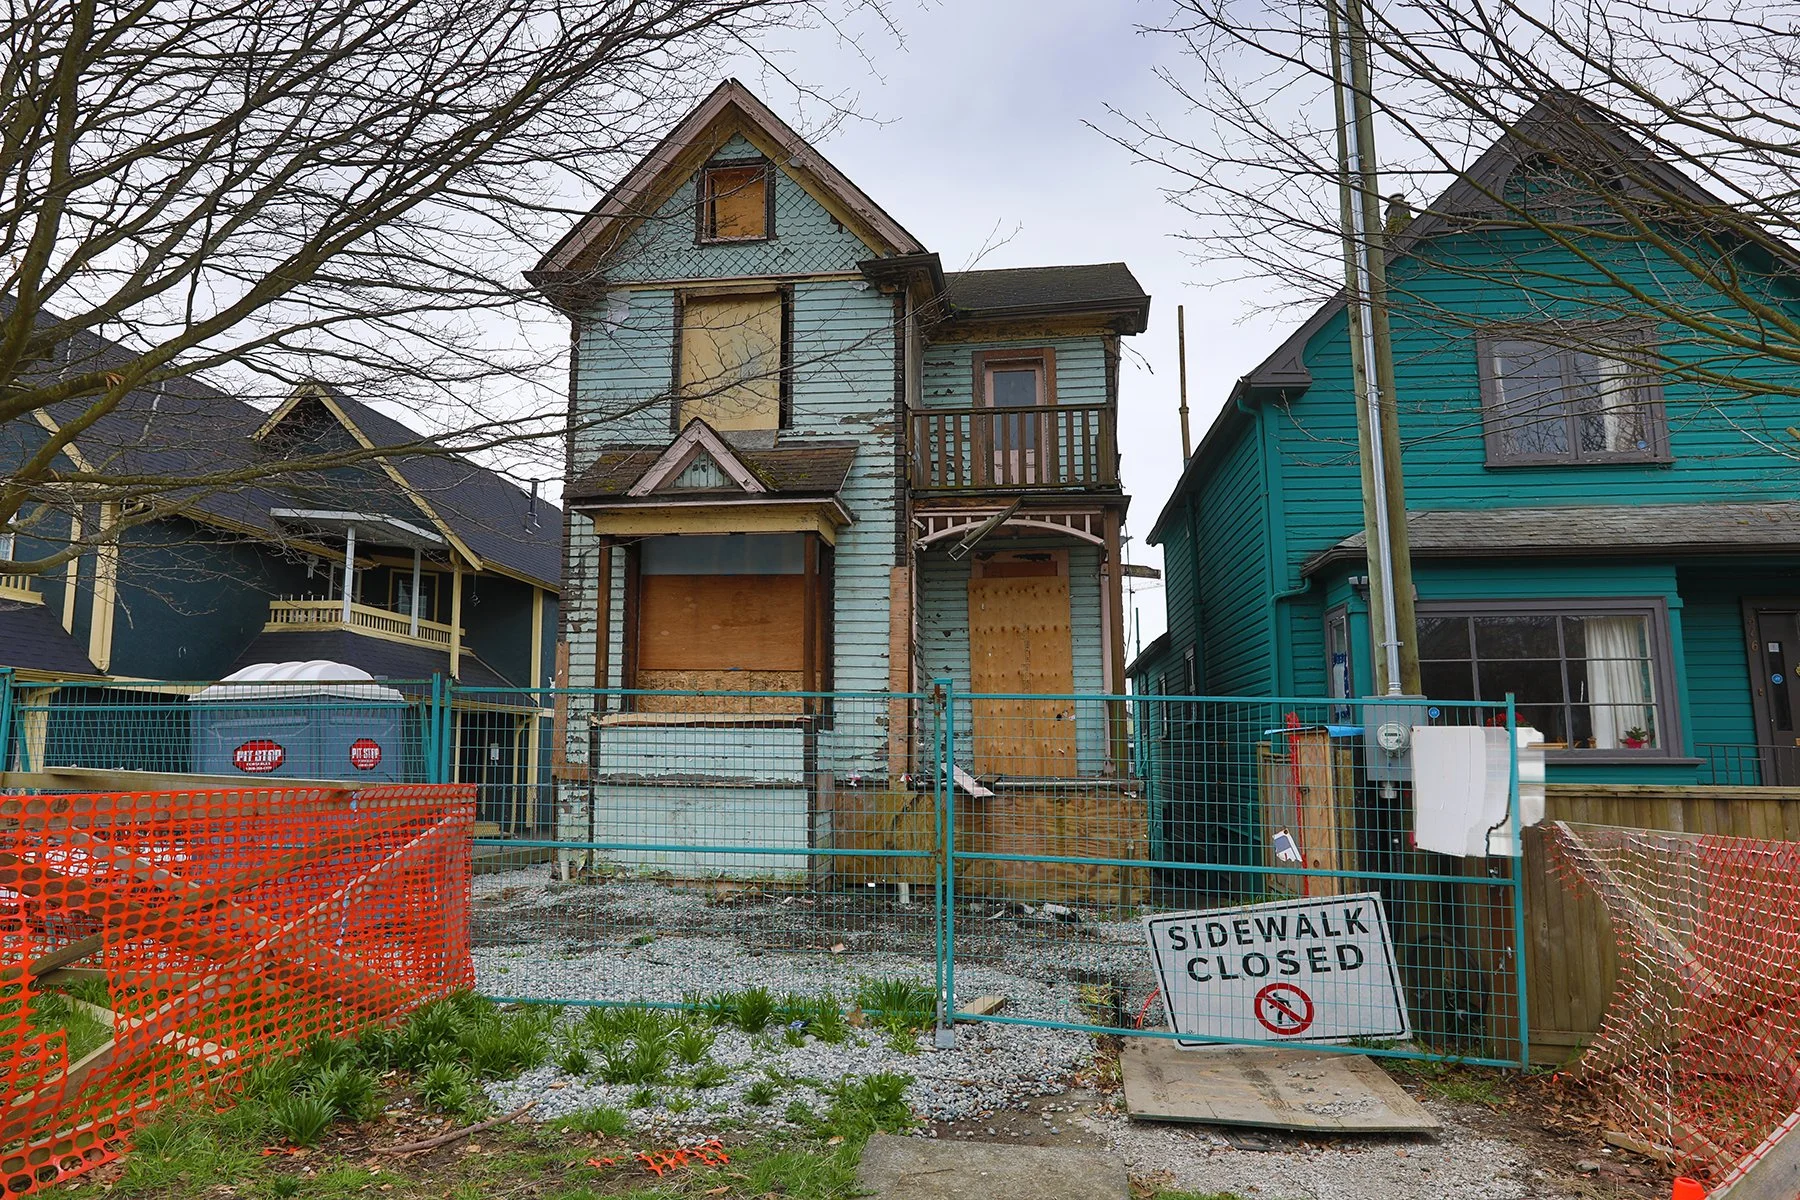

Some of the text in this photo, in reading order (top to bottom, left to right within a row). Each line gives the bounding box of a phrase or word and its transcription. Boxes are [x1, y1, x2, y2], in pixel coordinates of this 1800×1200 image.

[236, 749, 282, 762] PIT STOP
[351, 747, 380, 759] PIT STOP
[1168, 907, 1369, 951] SIDEWALK
[1187, 944, 1364, 982] CLOSED
